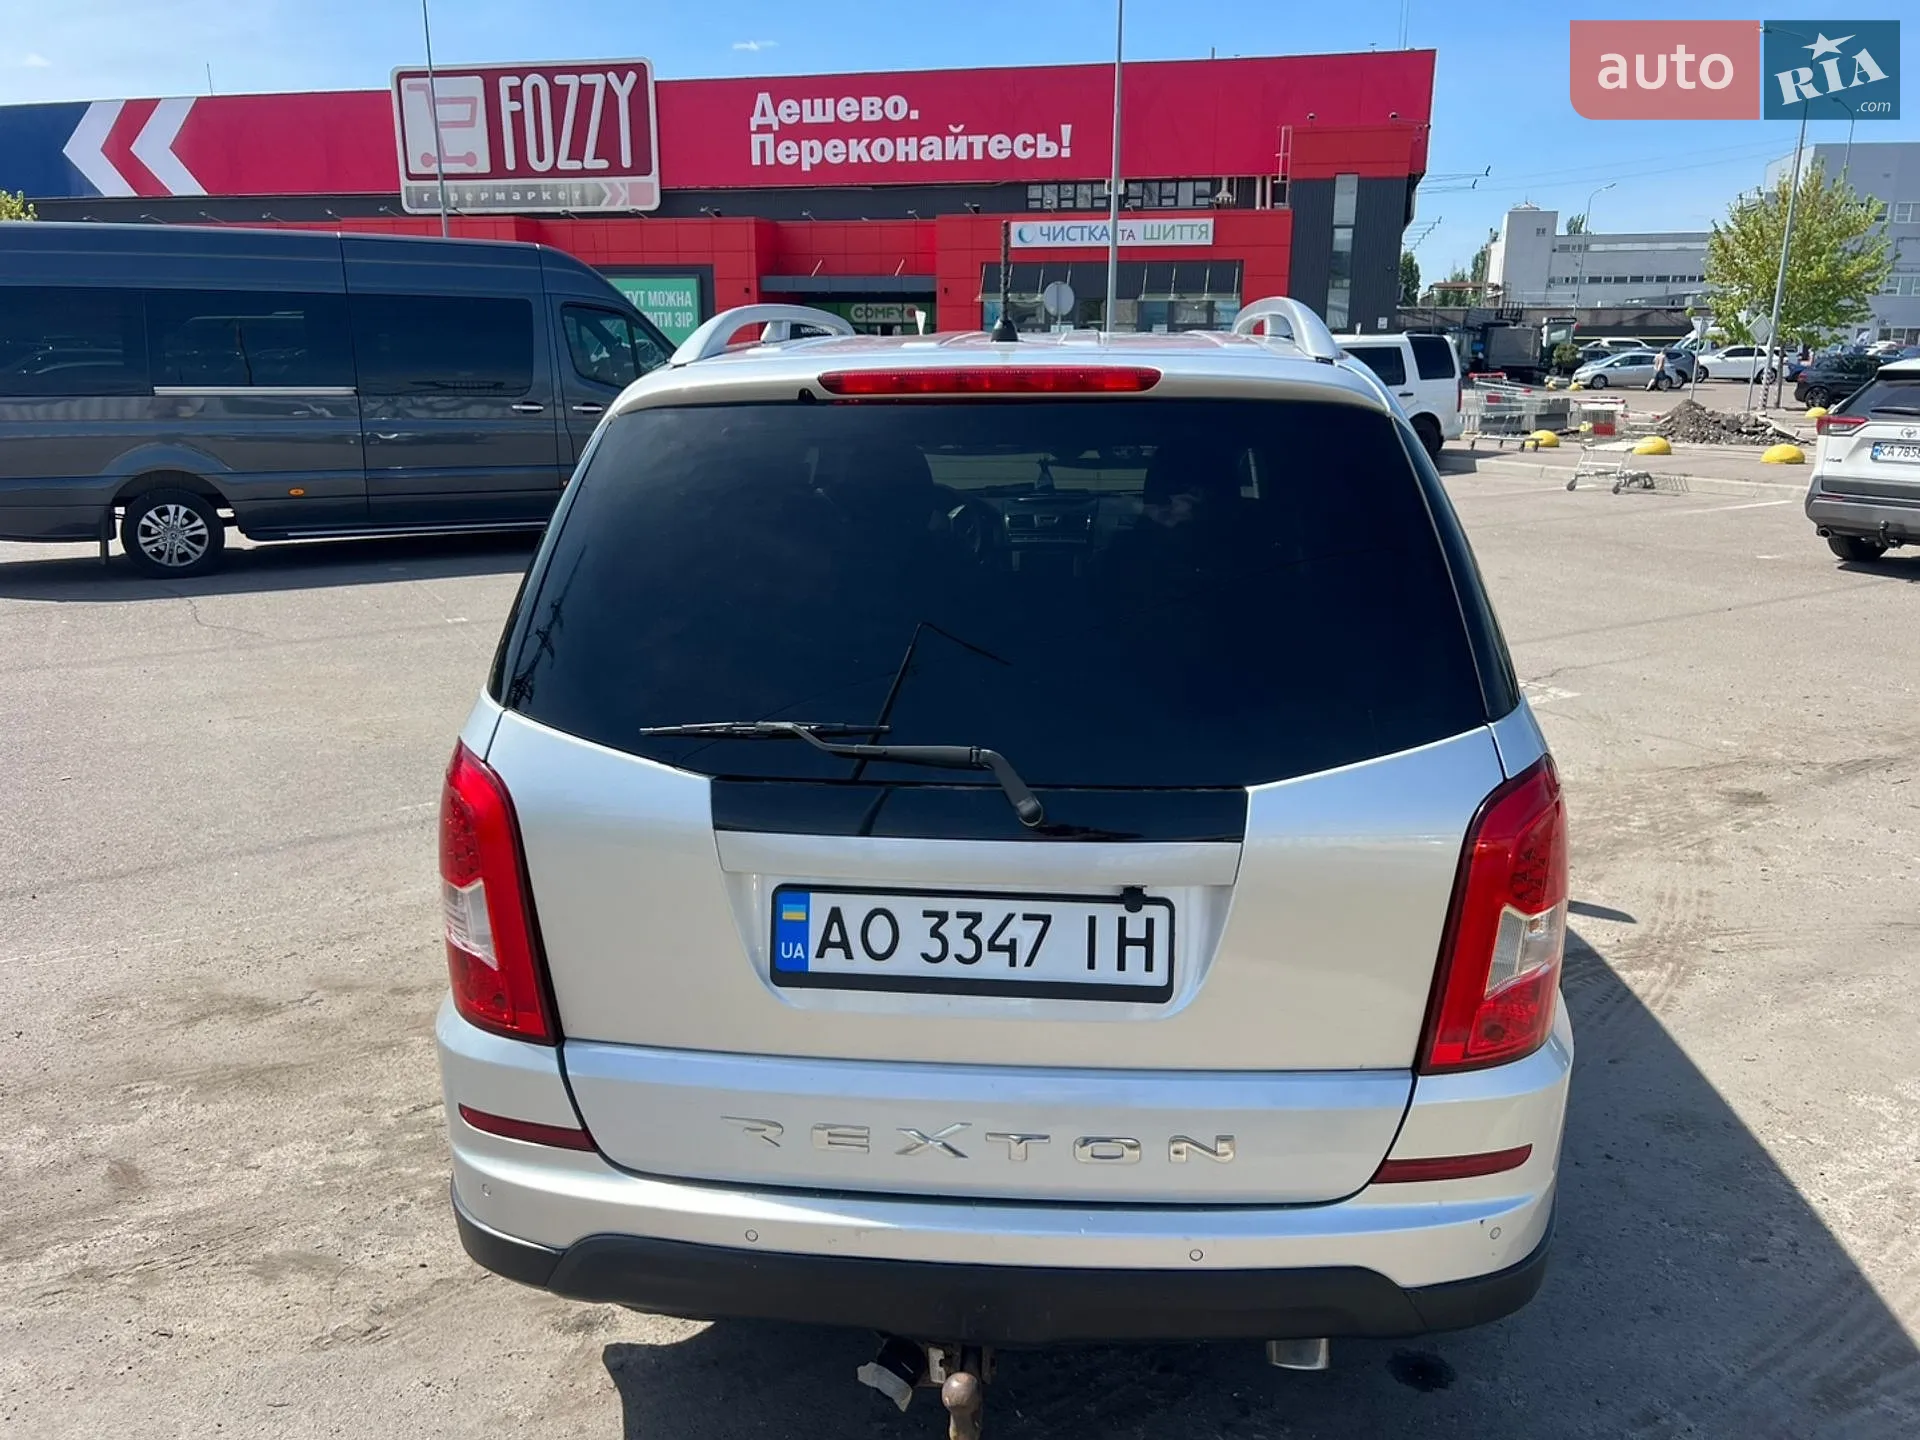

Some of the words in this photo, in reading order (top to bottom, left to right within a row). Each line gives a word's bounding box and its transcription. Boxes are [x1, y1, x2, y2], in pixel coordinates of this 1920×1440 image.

[500, 71, 637, 171] FOZZY
[750, 92, 919, 131] Дешево.
[751, 124, 1072, 171] Переконайтесь!
[1039, 225, 1111, 241] ЧИСТКА
[1119, 229, 1136, 241] ТА
[1143, 223, 1209, 241] ШИТТЯ
[648, 290, 692, 307] МОЖНА
[781, 942, 805, 959] UA
[815, 906, 900, 962] AO
[920, 909, 1053, 968] 3347
[1087, 914, 1155, 973] IH
[721, 1115, 1236, 1165] REXTON
